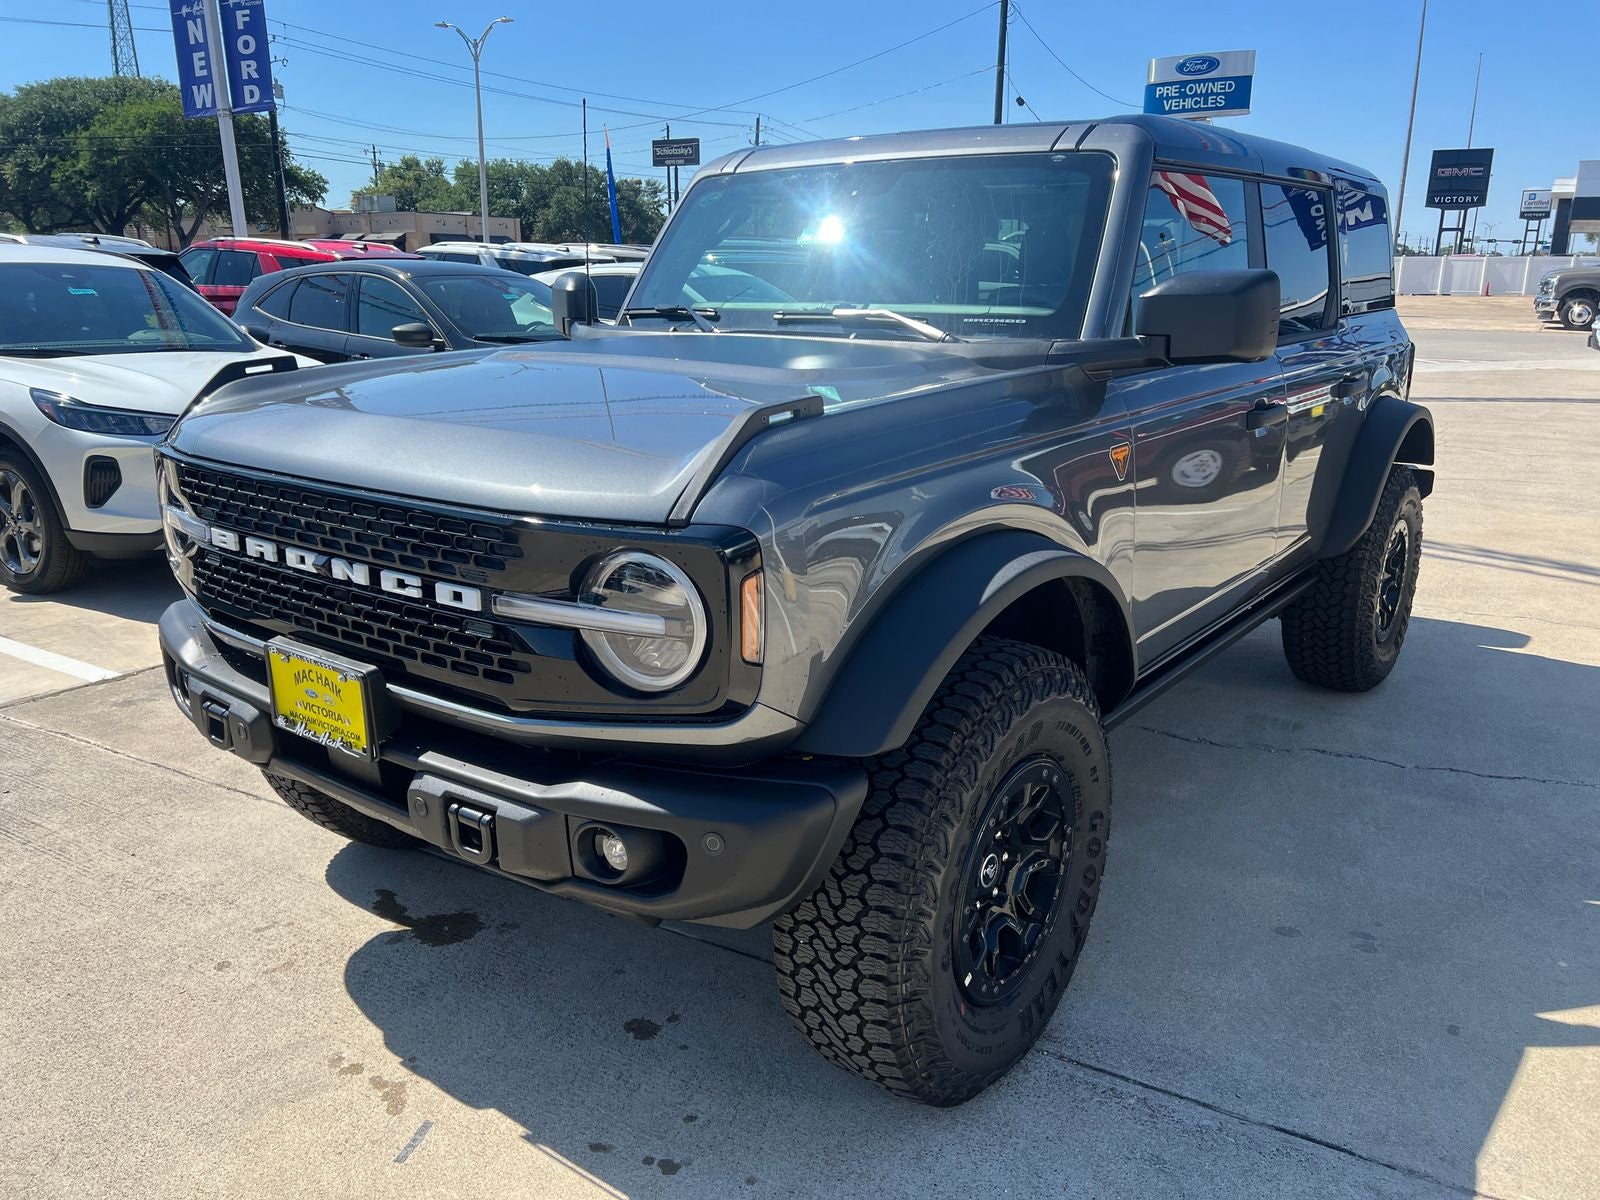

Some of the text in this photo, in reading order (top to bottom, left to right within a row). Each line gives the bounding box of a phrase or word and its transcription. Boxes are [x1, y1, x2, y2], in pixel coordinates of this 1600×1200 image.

[186, 18, 213, 109] NEW
[235, 9, 260, 104] FORD
[1183, 60, 1208, 72] Ford
[1163, 95, 1225, 111] VEHICLES
[656, 146, 692, 156] Schlotzsky's
[1437, 167, 1484, 177] GMC
[1434, 195, 1479, 204] VICTORY
[210, 526, 482, 612] BRONCO
[293, 669, 314, 686] MAC
[315, 672, 343, 702] HAIK
[301, 700, 344, 724] VICTORIA
[294, 721, 318, 740] Mac
[1055, 721, 1092, 757] TERRITORY
[1019, 810, 1105, 1036] GOODYEAR
